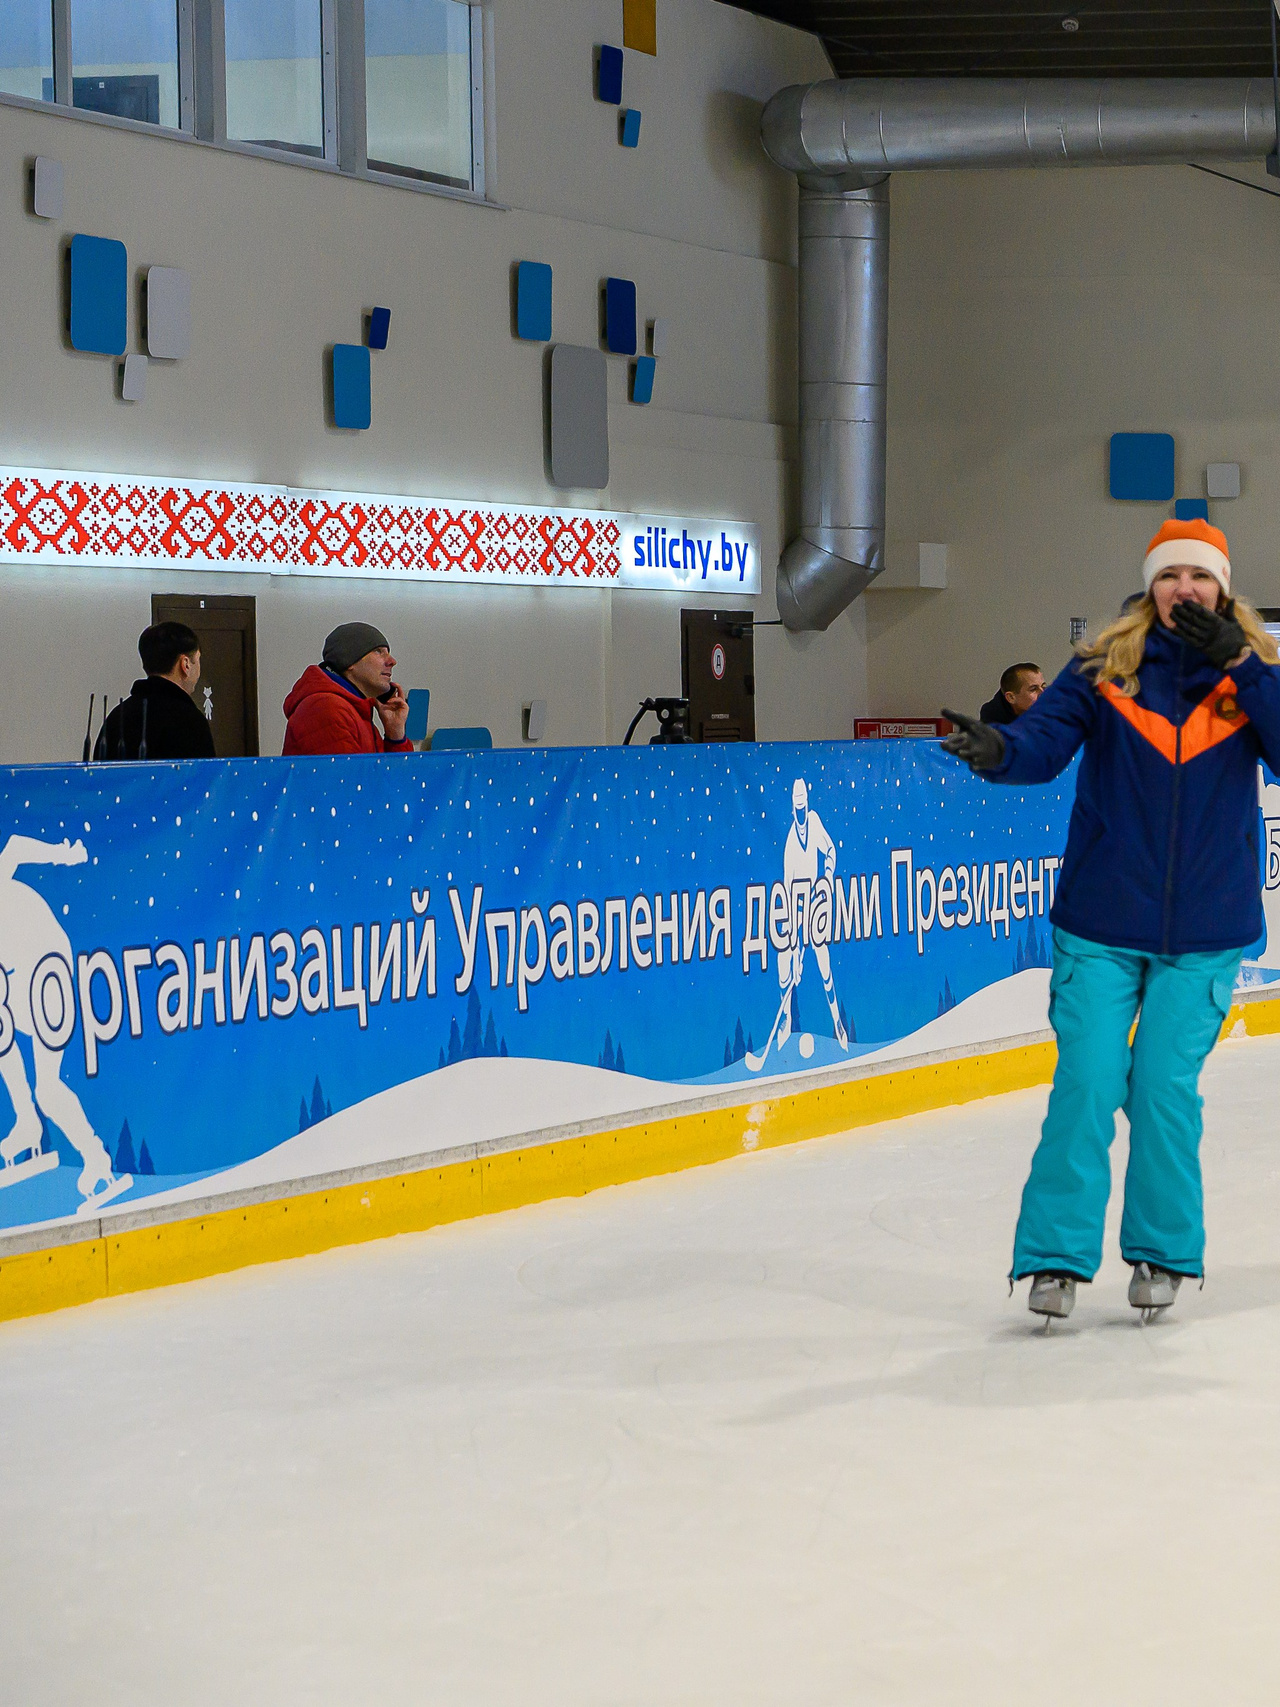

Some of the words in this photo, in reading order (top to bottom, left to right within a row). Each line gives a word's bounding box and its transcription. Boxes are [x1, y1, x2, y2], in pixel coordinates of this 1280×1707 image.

[634, 526, 749, 582] silichy.by
[30, 888, 437, 1076] организаций
[447, 884, 733, 1013] Управления
[742, 871, 883, 975] делами
[891, 847, 1065, 956] Президент
